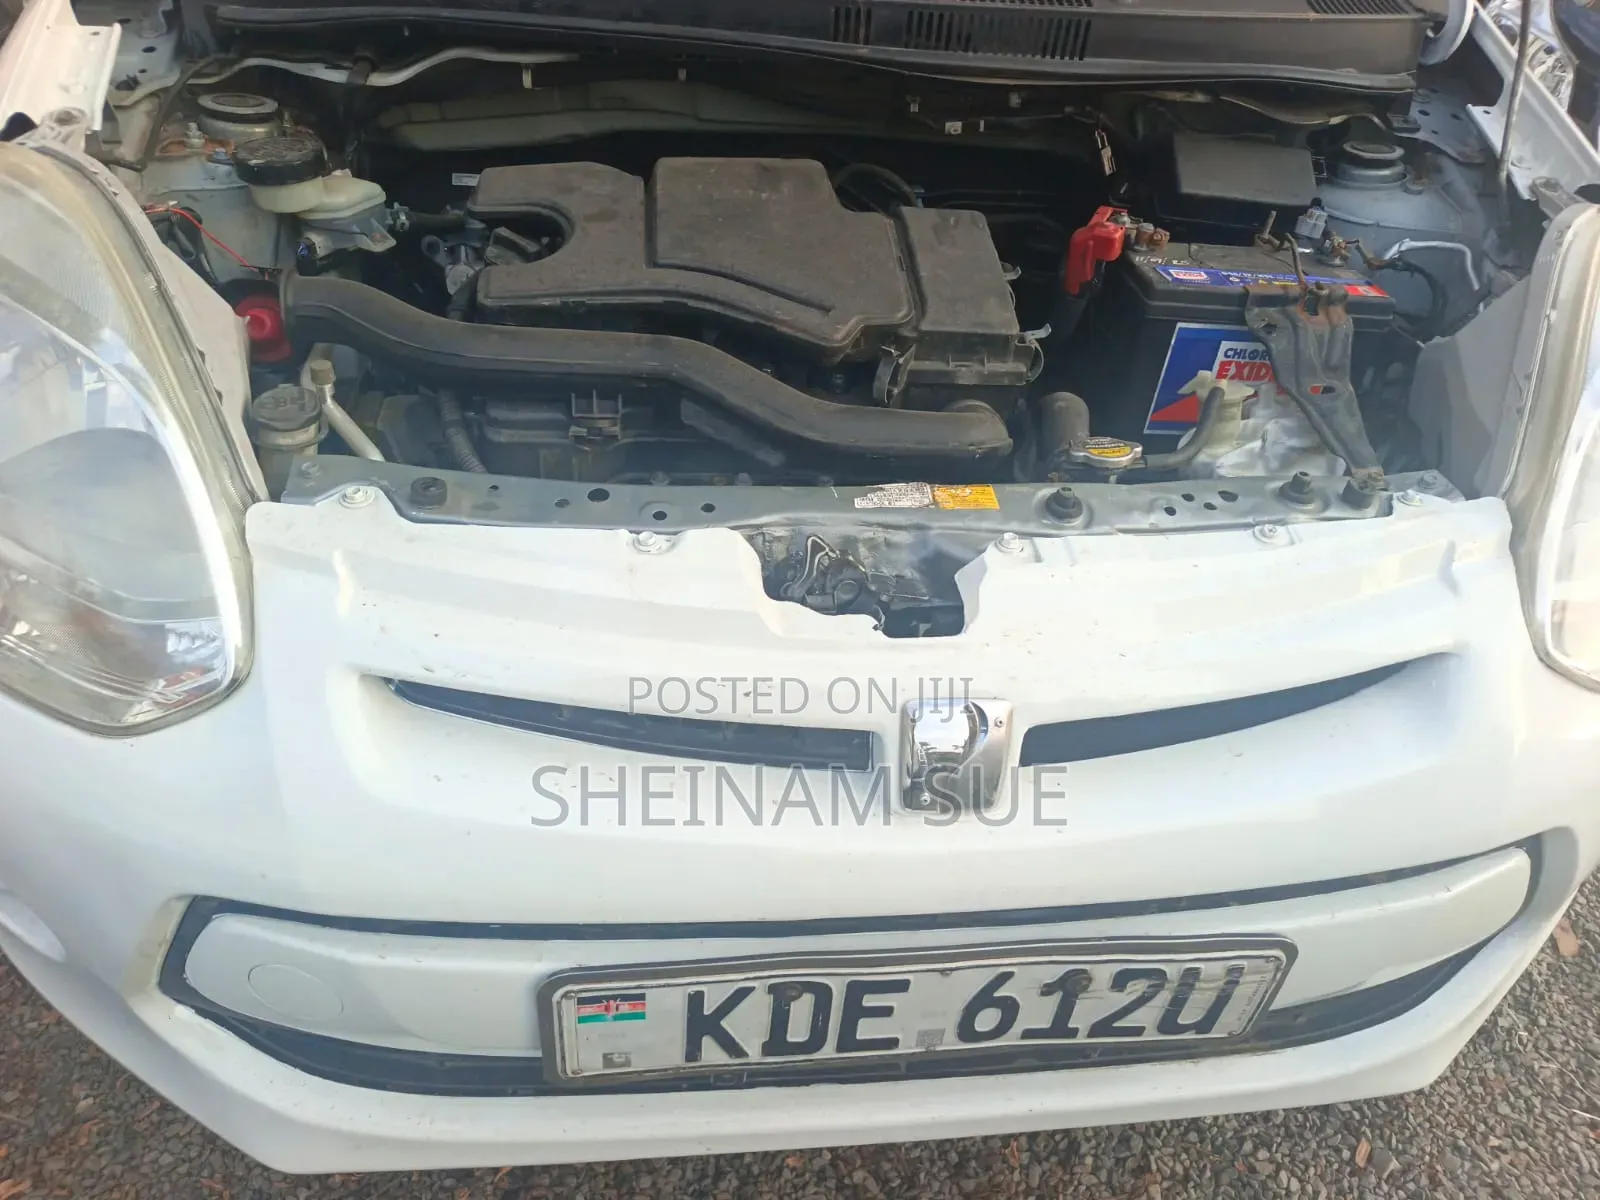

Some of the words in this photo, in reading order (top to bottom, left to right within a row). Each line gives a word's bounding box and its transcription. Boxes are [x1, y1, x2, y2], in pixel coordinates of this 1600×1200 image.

[1215, 360, 1275, 383] EXID
[684, 978, 911, 1063] KDE
[956, 962, 1247, 1044] 612U
